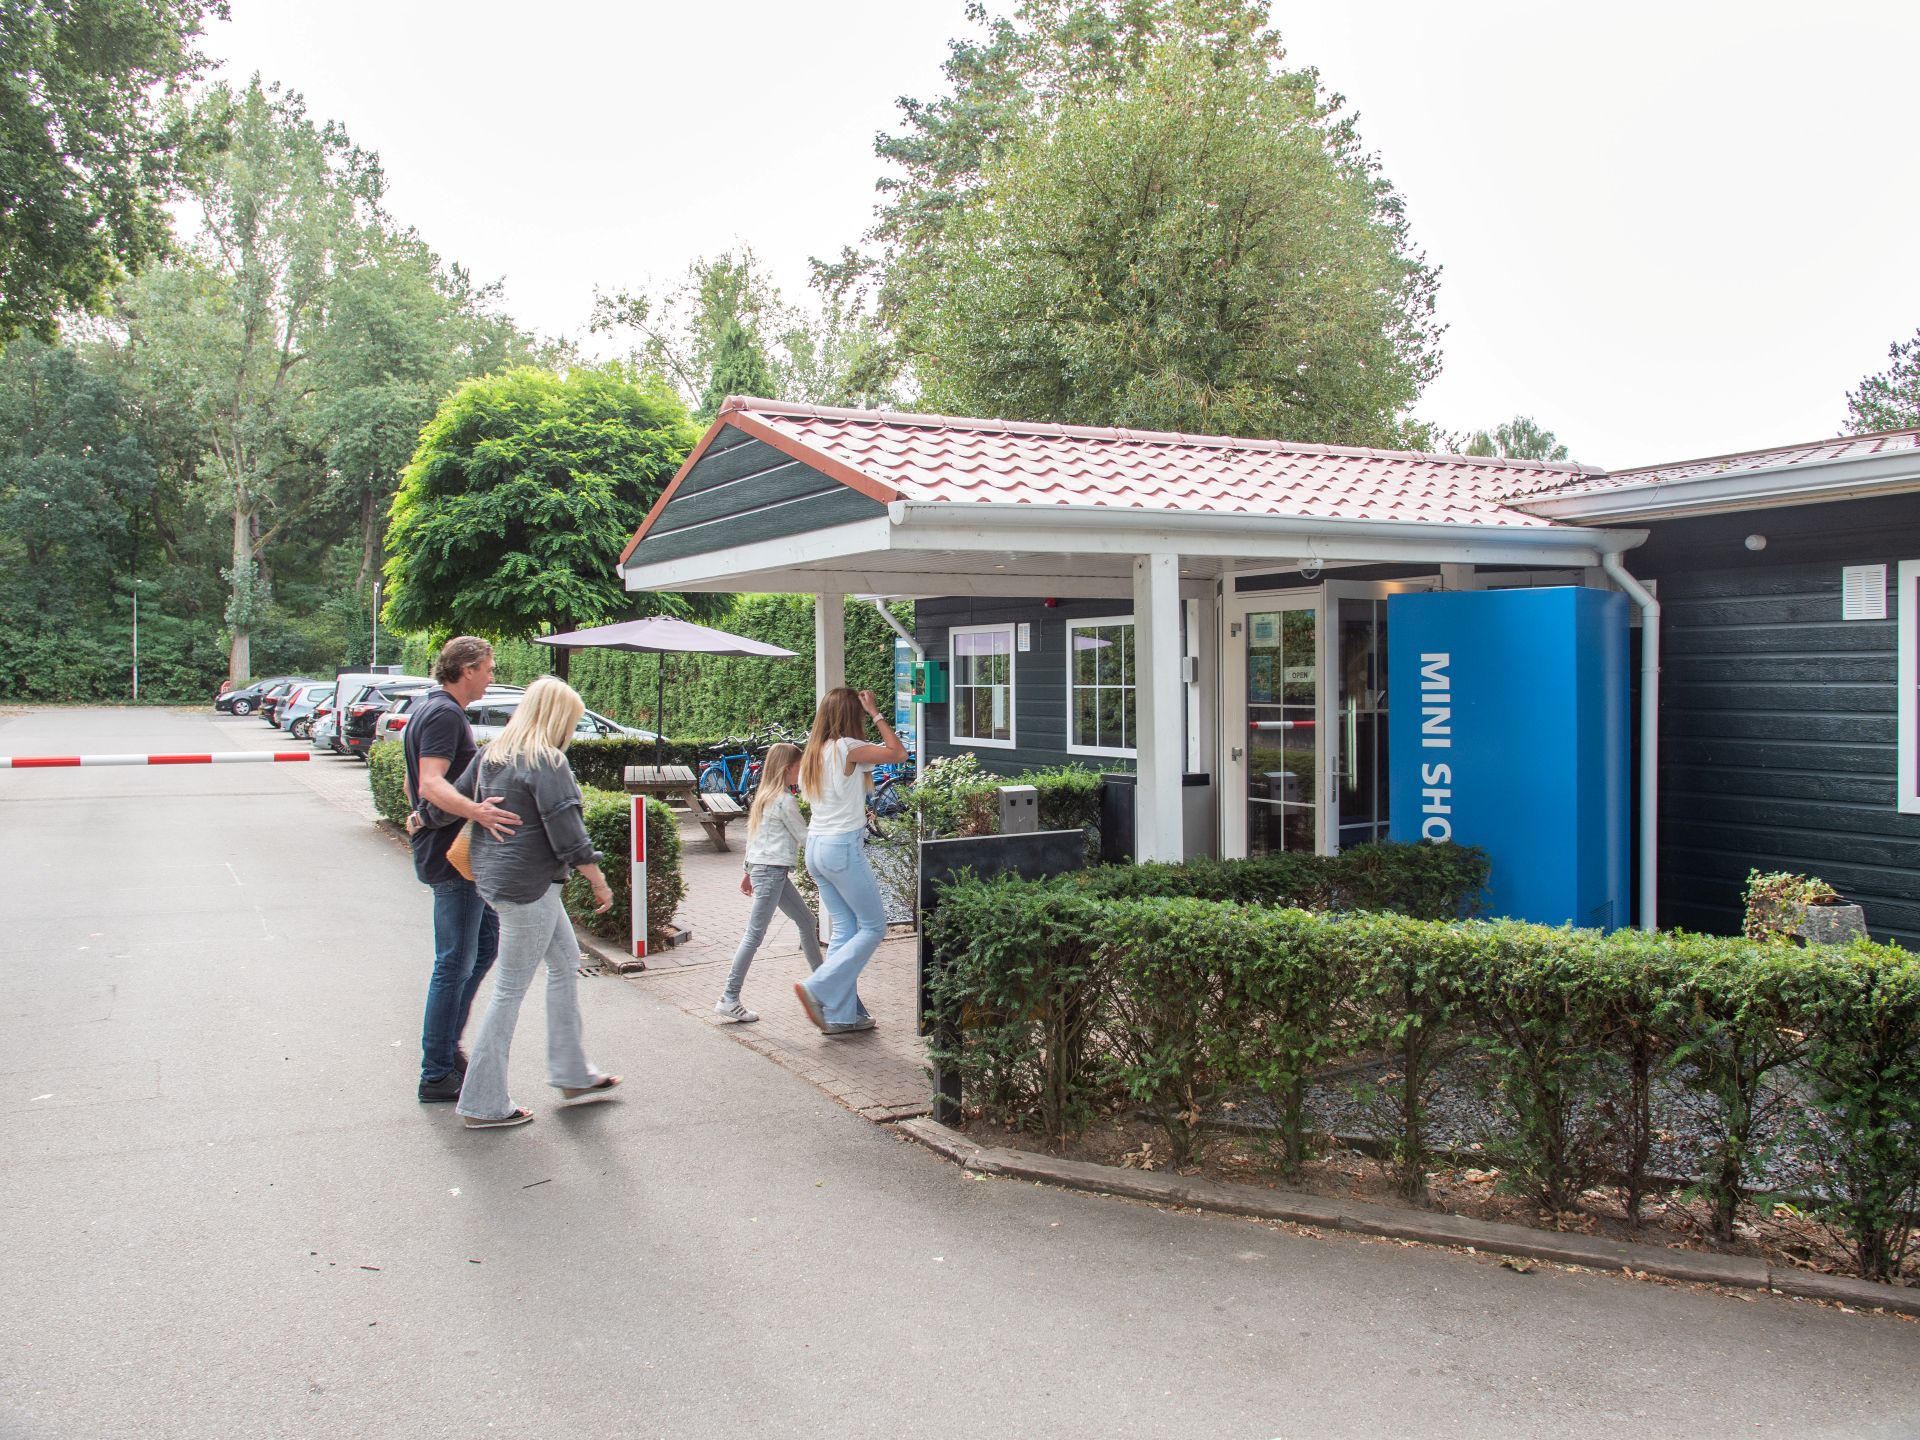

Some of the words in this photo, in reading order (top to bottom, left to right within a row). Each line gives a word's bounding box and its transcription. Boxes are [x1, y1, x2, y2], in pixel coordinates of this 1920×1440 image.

[1291, 671, 1308, 679] OPEN
[1420, 653, 1451, 747] MINI
[1421, 763, 1452, 845] SHO
